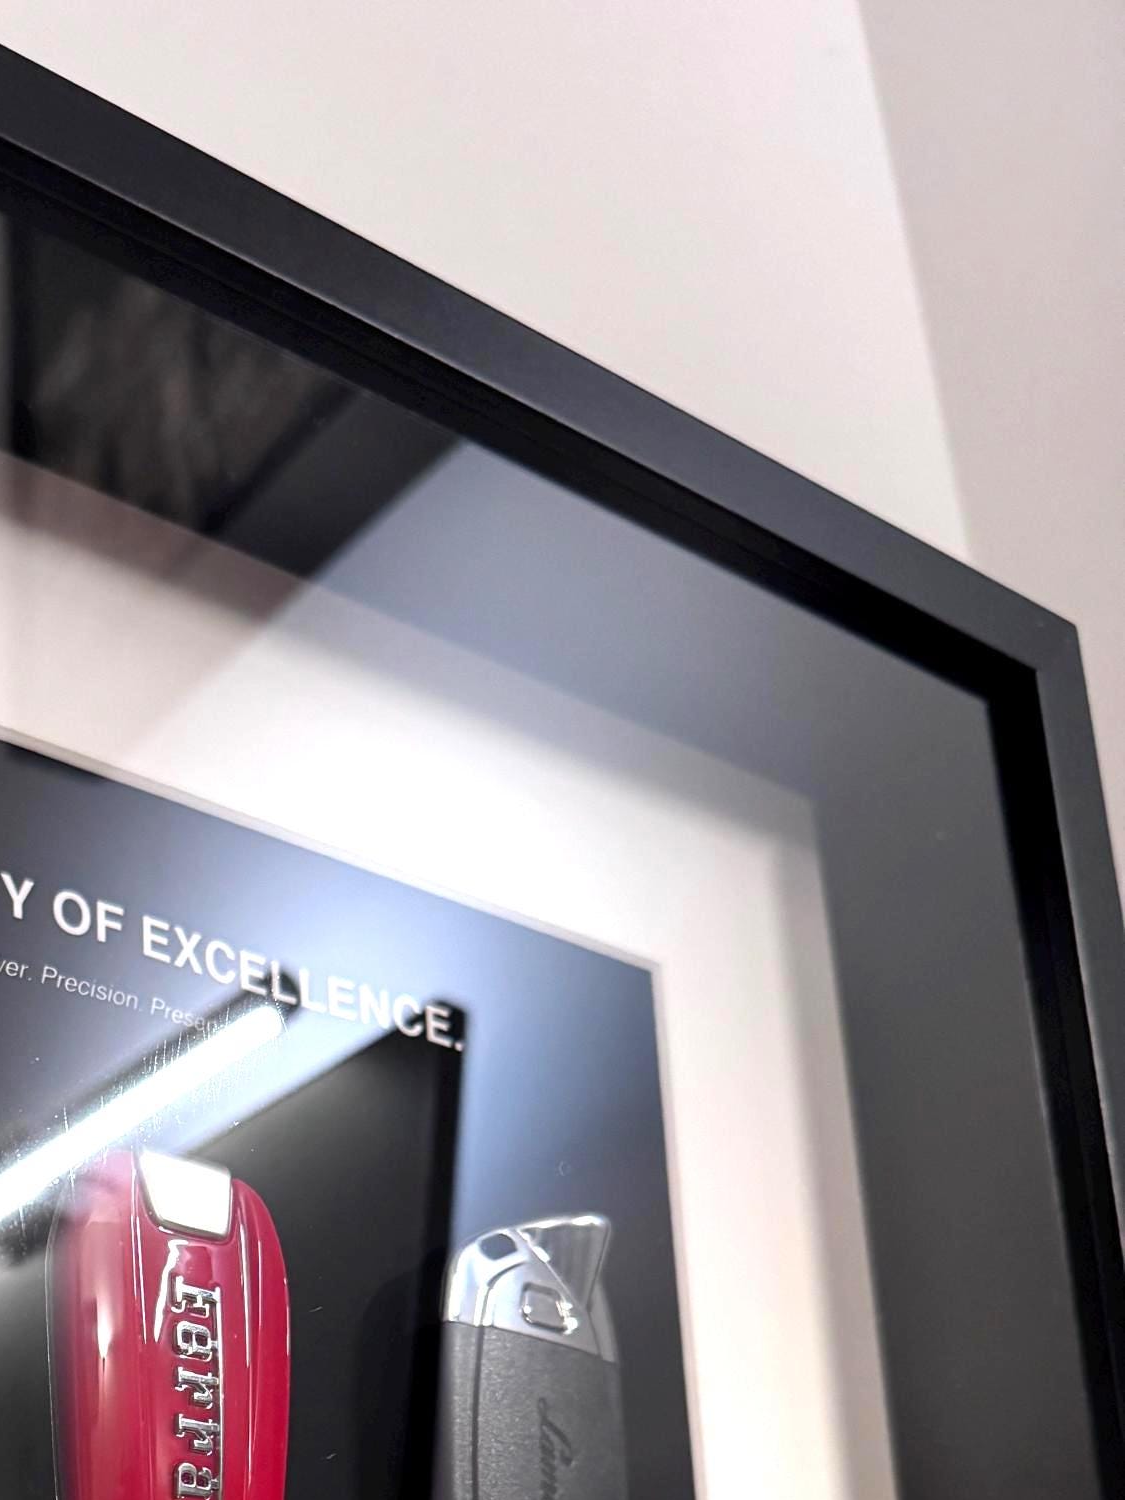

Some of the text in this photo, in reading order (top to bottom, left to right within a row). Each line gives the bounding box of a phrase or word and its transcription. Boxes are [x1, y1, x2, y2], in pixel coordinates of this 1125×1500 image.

[40, 965, 142, 1013] Precision.
[53, 889, 124, 943] OF
[142, 914, 465, 1052] EXCELLENCE.
